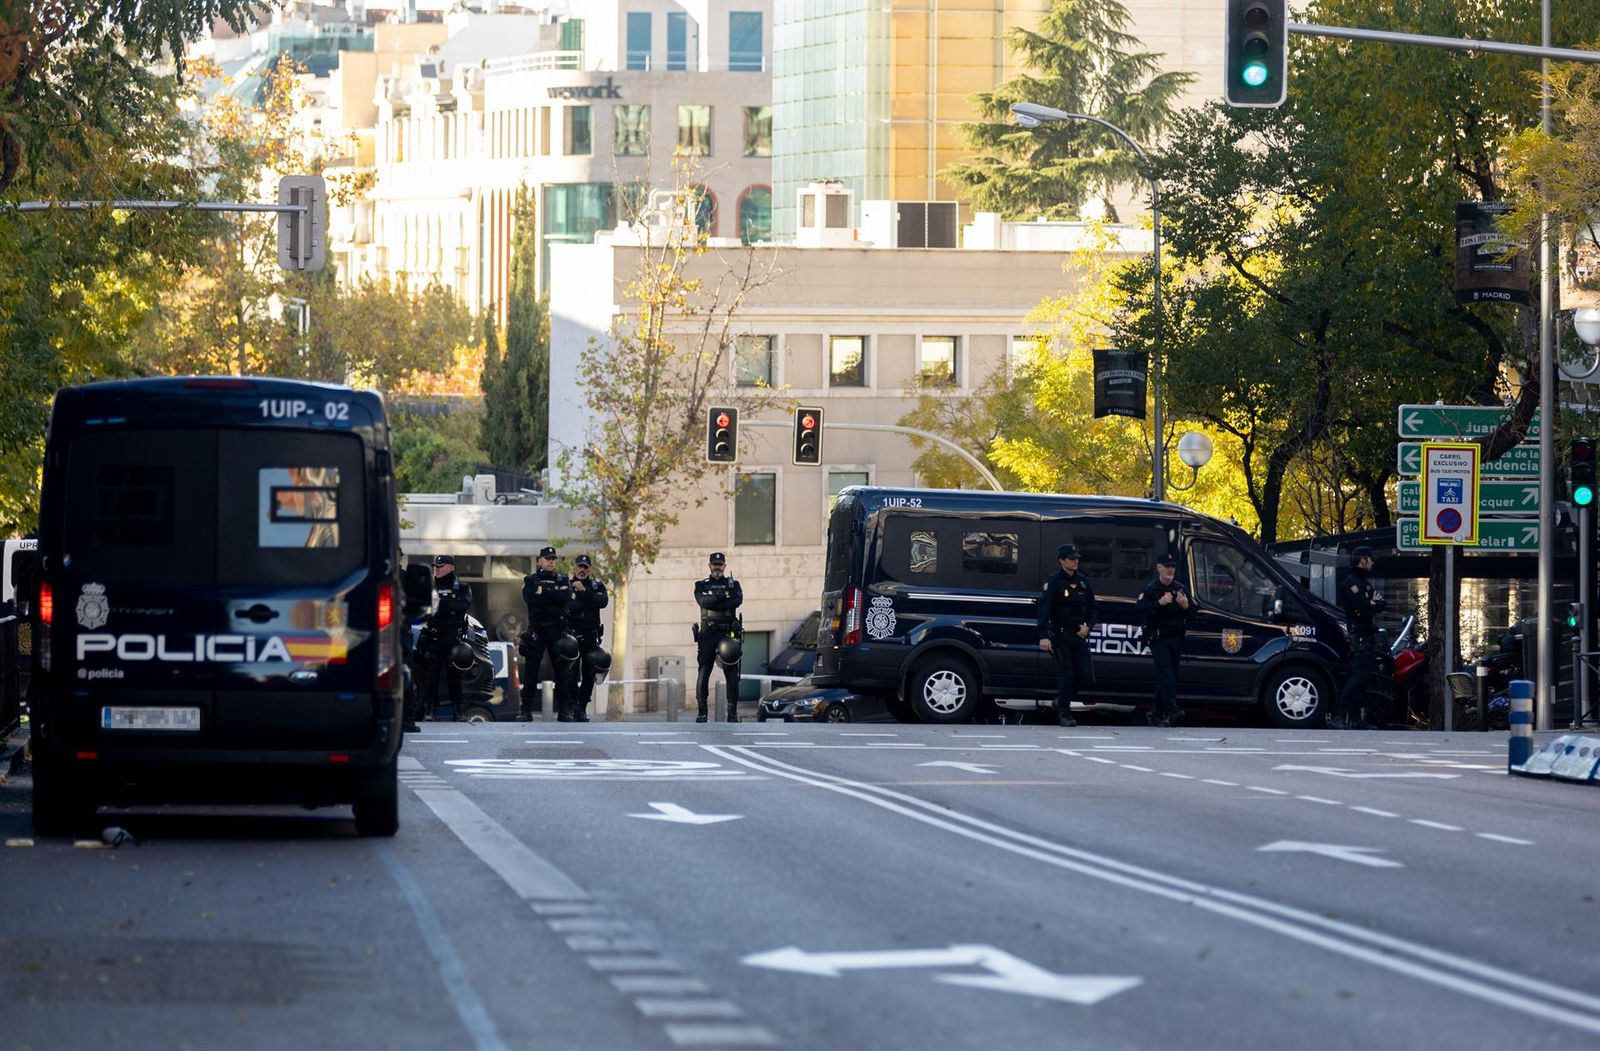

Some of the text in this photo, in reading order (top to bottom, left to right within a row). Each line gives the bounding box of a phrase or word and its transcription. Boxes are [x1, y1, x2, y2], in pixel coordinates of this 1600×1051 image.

[1482, 292, 1511, 300] MADRID
[259, 399, 349, 420] 1UIP- 02
[1515, 450, 1528, 459] de
[1530, 450, 1540, 459] la
[1480, 461, 1540, 472] endencia
[883, 497, 922, 508] 1UIP-52
[1480, 499, 1515, 508] cquer
[78, 668, 124, 680] @policia
